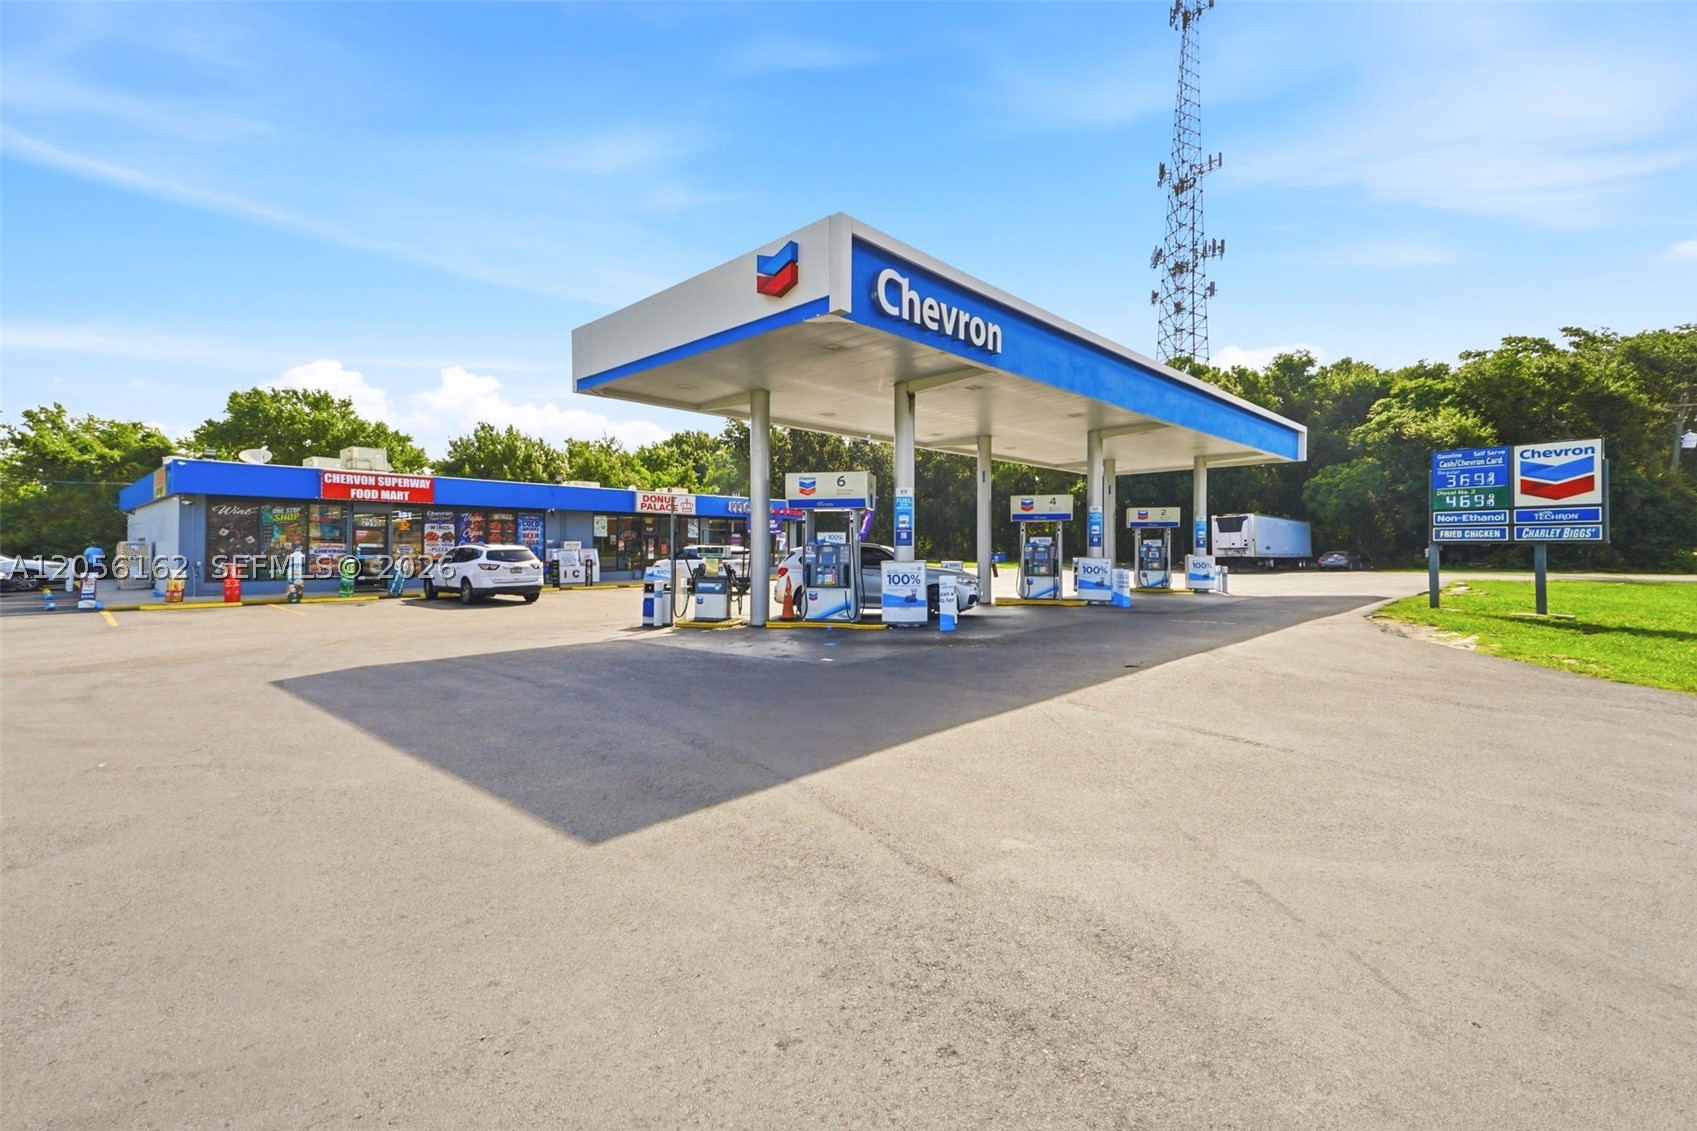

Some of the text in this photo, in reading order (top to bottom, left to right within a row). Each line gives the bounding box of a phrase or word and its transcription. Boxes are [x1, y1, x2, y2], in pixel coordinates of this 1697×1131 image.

[877, 268, 1002, 354] Chevron
[1519, 445, 1595, 460] Chevron
[1439, 457, 1503, 468] Cash/Chevron Card
[324, 473, 431, 489] CHERVON SUPERWAY
[836, 475, 846, 487] 6
[350, 489, 410, 500] FOOD MART
[1049, 497, 1056, 506] 4
[212, 505, 259, 515] Wine
[640, 503, 679, 511] PALACE
[274, 513, 300, 522] SHOP
[1437, 513, 1505, 522] Non-Ethanol
[1440, 530, 1501, 538] FRIED CHICKEN
[1522, 528, 1562, 538] CHARLEY
[1082, 565, 1108, 575] 100%
[887, 574, 921, 585] 100%
